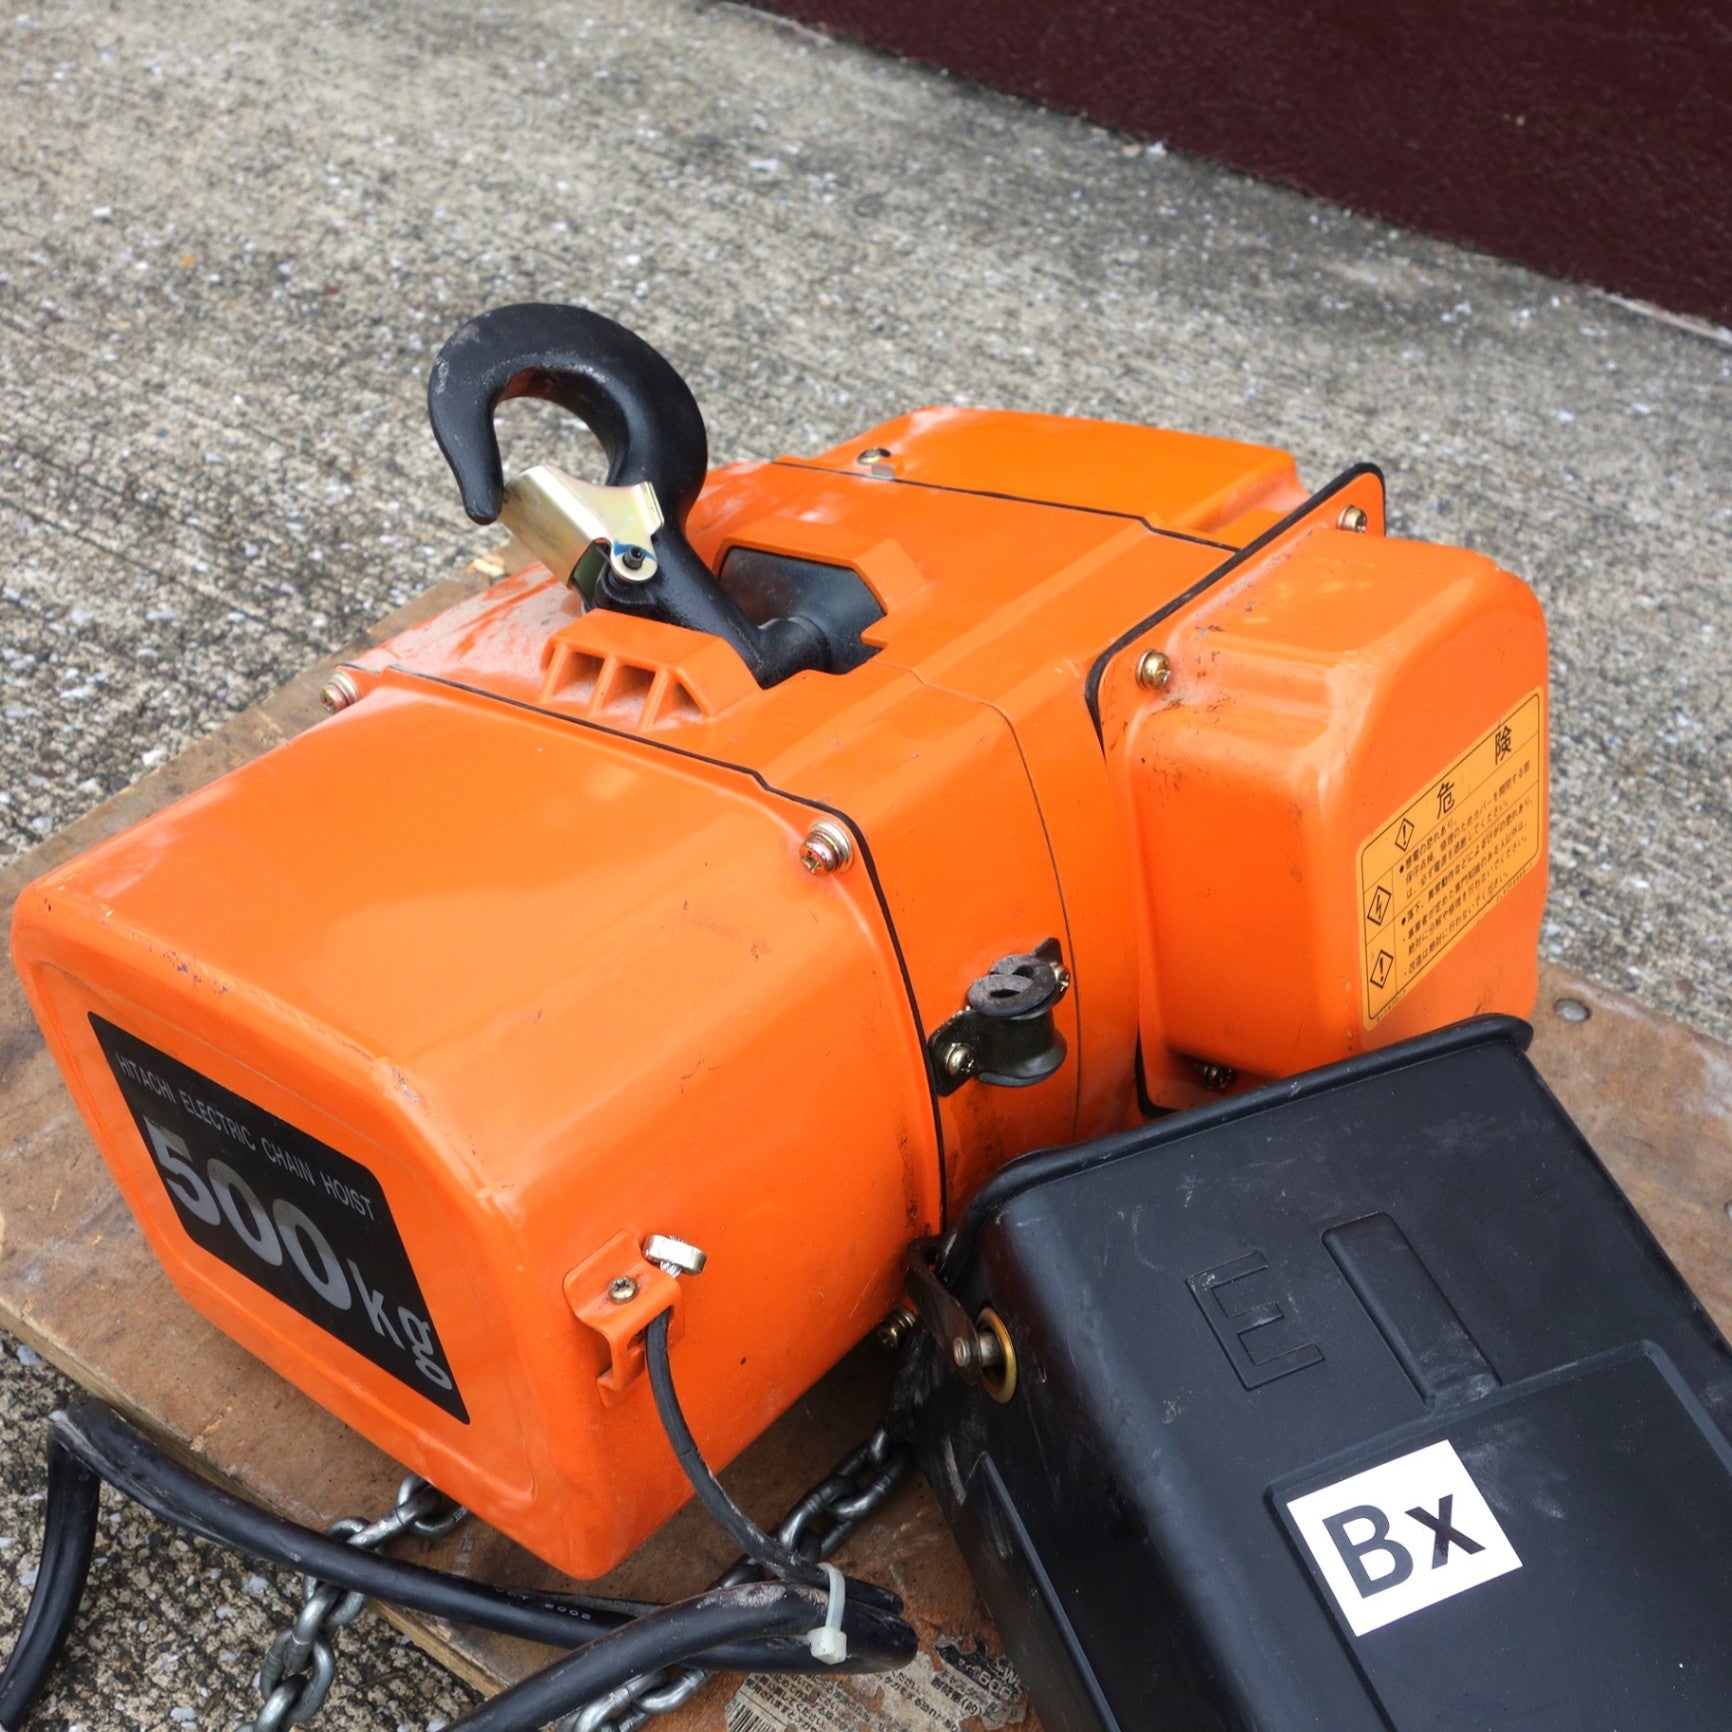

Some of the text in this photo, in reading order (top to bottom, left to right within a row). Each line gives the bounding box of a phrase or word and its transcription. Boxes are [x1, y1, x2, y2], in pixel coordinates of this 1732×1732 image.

[1436, 725, 1512, 821] 危 険
[117, 1054, 373, 1221] HITACHI ELECTRIC CHAIN HOIST
[1322, 1494, 1485, 1598] Bx
